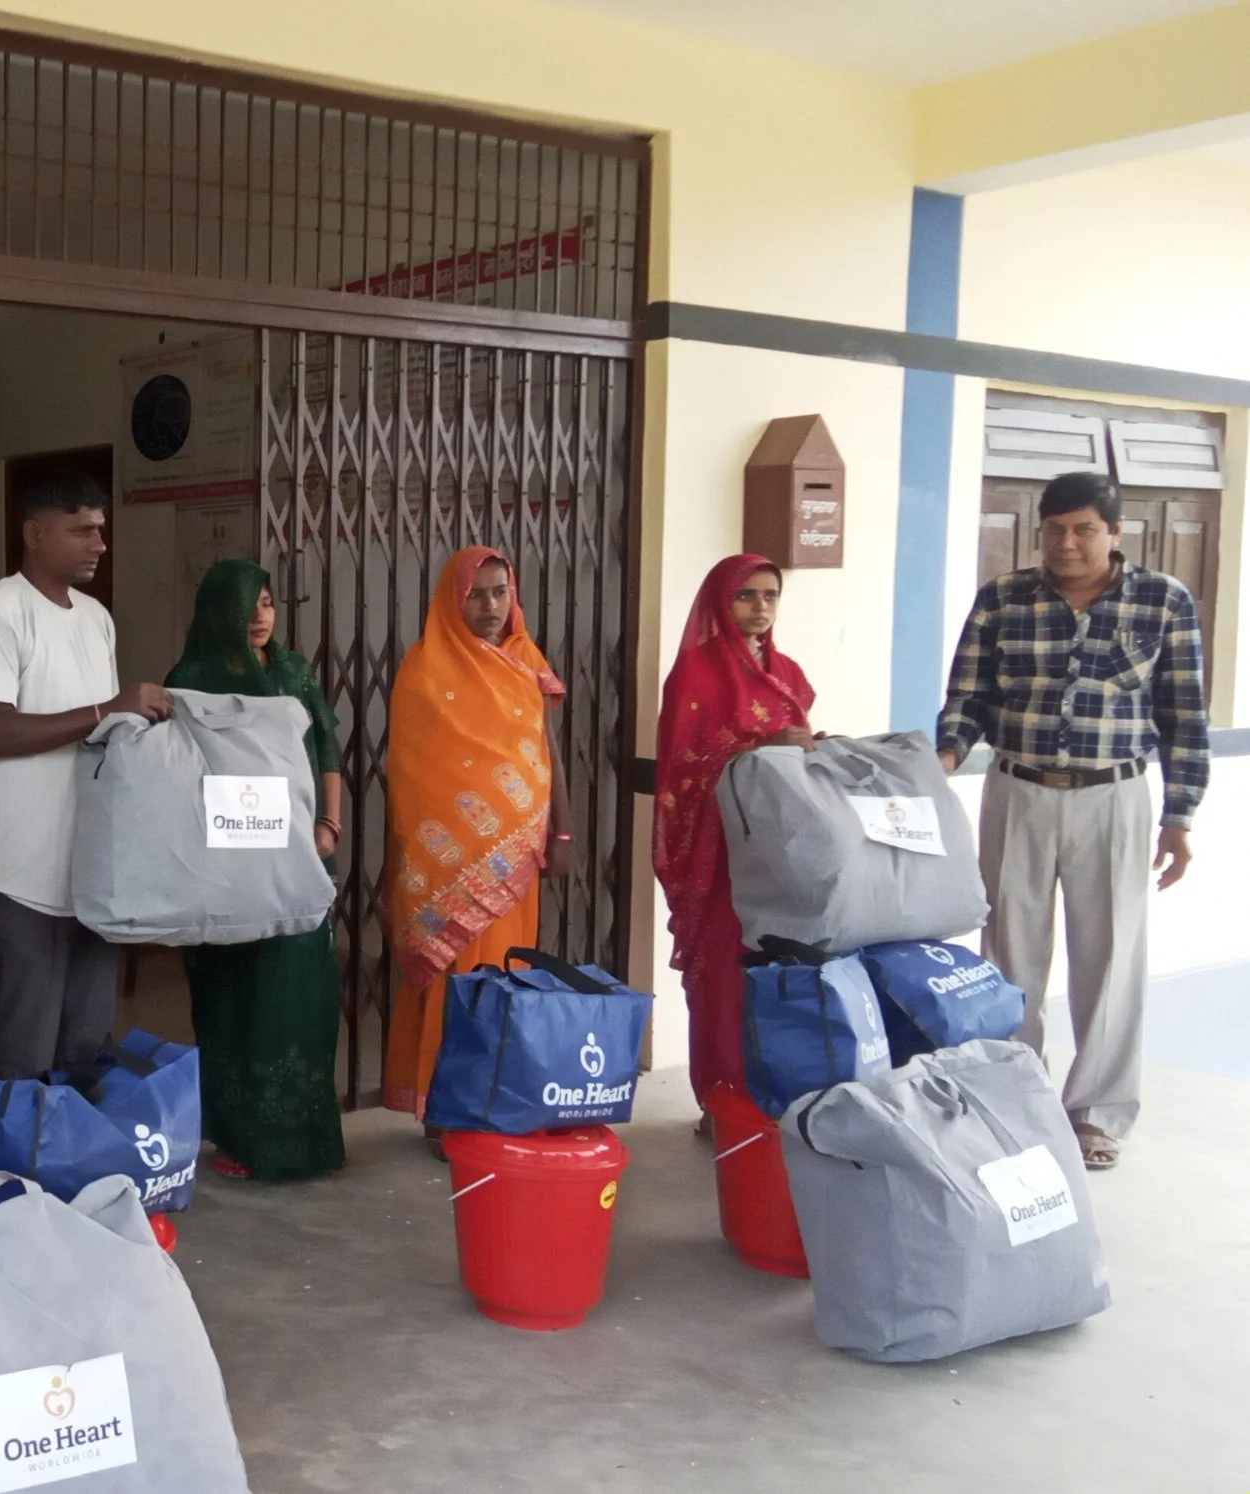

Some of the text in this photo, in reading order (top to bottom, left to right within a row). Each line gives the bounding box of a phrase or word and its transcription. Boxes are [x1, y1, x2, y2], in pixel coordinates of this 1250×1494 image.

[213, 815, 284, 830] One Heart
[895, 826, 935, 841] Heart
[927, 960, 1000, 994] One Heart
[542, 1081, 631, 1106] One Heart
[558, 1107, 613, 1118] WORLDWIDE
[143, 1158, 196, 1200] Heart
[1010, 1205, 1037, 1222] One
[1034, 1191, 1068, 1214] Heart
[4, 1416, 123, 1461] One Heart
[29, 1449, 102, 1473] WORLDWIDE
